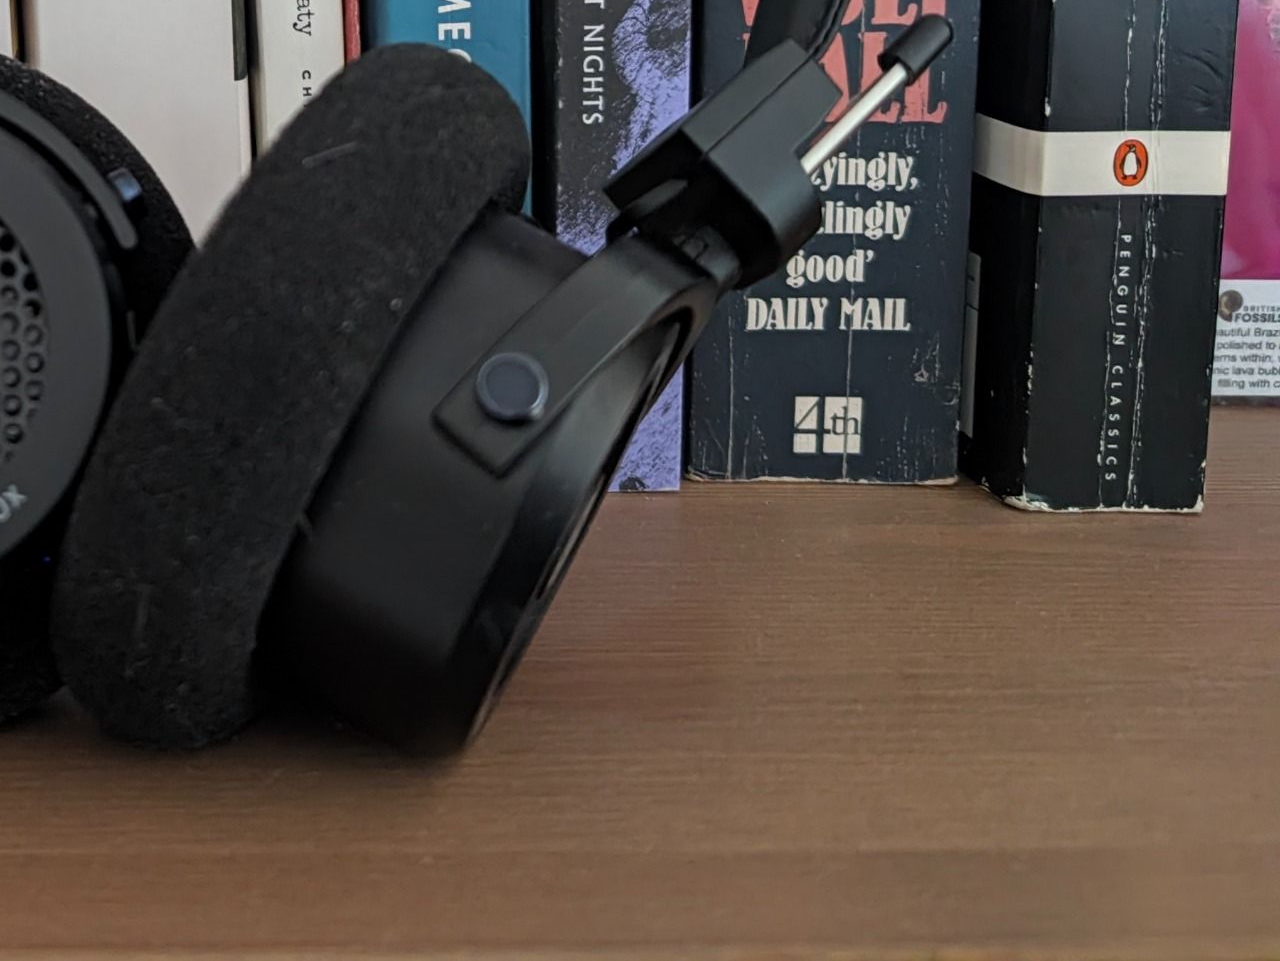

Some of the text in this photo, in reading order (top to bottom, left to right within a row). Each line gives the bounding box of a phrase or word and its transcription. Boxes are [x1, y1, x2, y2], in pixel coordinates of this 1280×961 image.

[581, 24, 605, 126] NIGHTS
[746, 297, 911, 331] DAILY MAIL
[1104, 234, 1132, 481] PENGUIN CLASSICS
[1249, 379, 1271, 389] with
